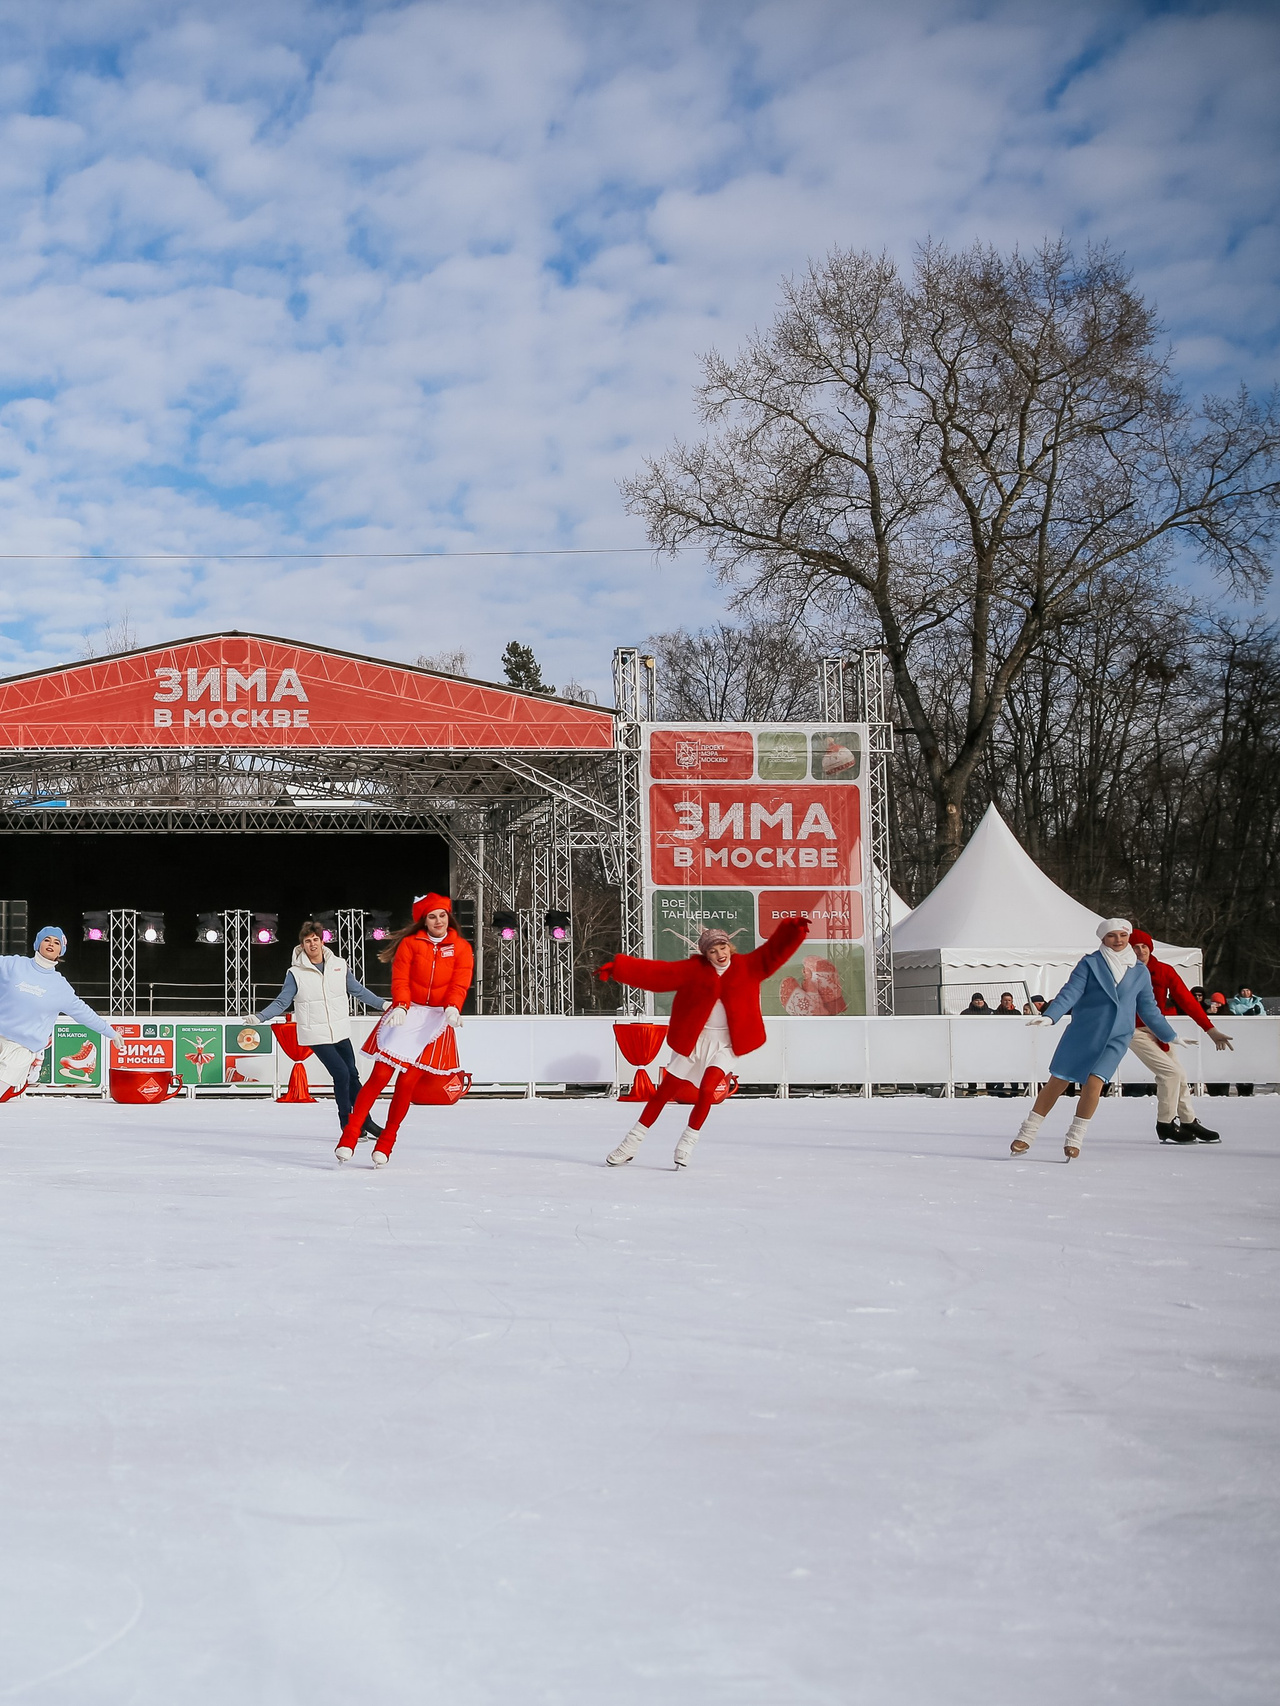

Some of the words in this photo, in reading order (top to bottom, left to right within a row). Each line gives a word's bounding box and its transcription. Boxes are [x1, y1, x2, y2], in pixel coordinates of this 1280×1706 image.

[153, 667, 309, 702] ЗИМА
[153, 709, 173, 728] В
[184, 709, 309, 728] МОСКВЕ
[673, 801, 837, 840] ЗИМА
[673, 847, 693, 867] В
[704, 847, 838, 868] МОСКВЕ
[661, 899, 685, 908] ВСЕ
[661, 910, 737, 920] ТАНЦЕВАТЬ!
[772, 910, 796, 919] ВСЕ
[800, 910, 808, 919] В
[812, 910, 850, 919] ПАРК!
[118, 1044, 165, 1056] ЗИМА
